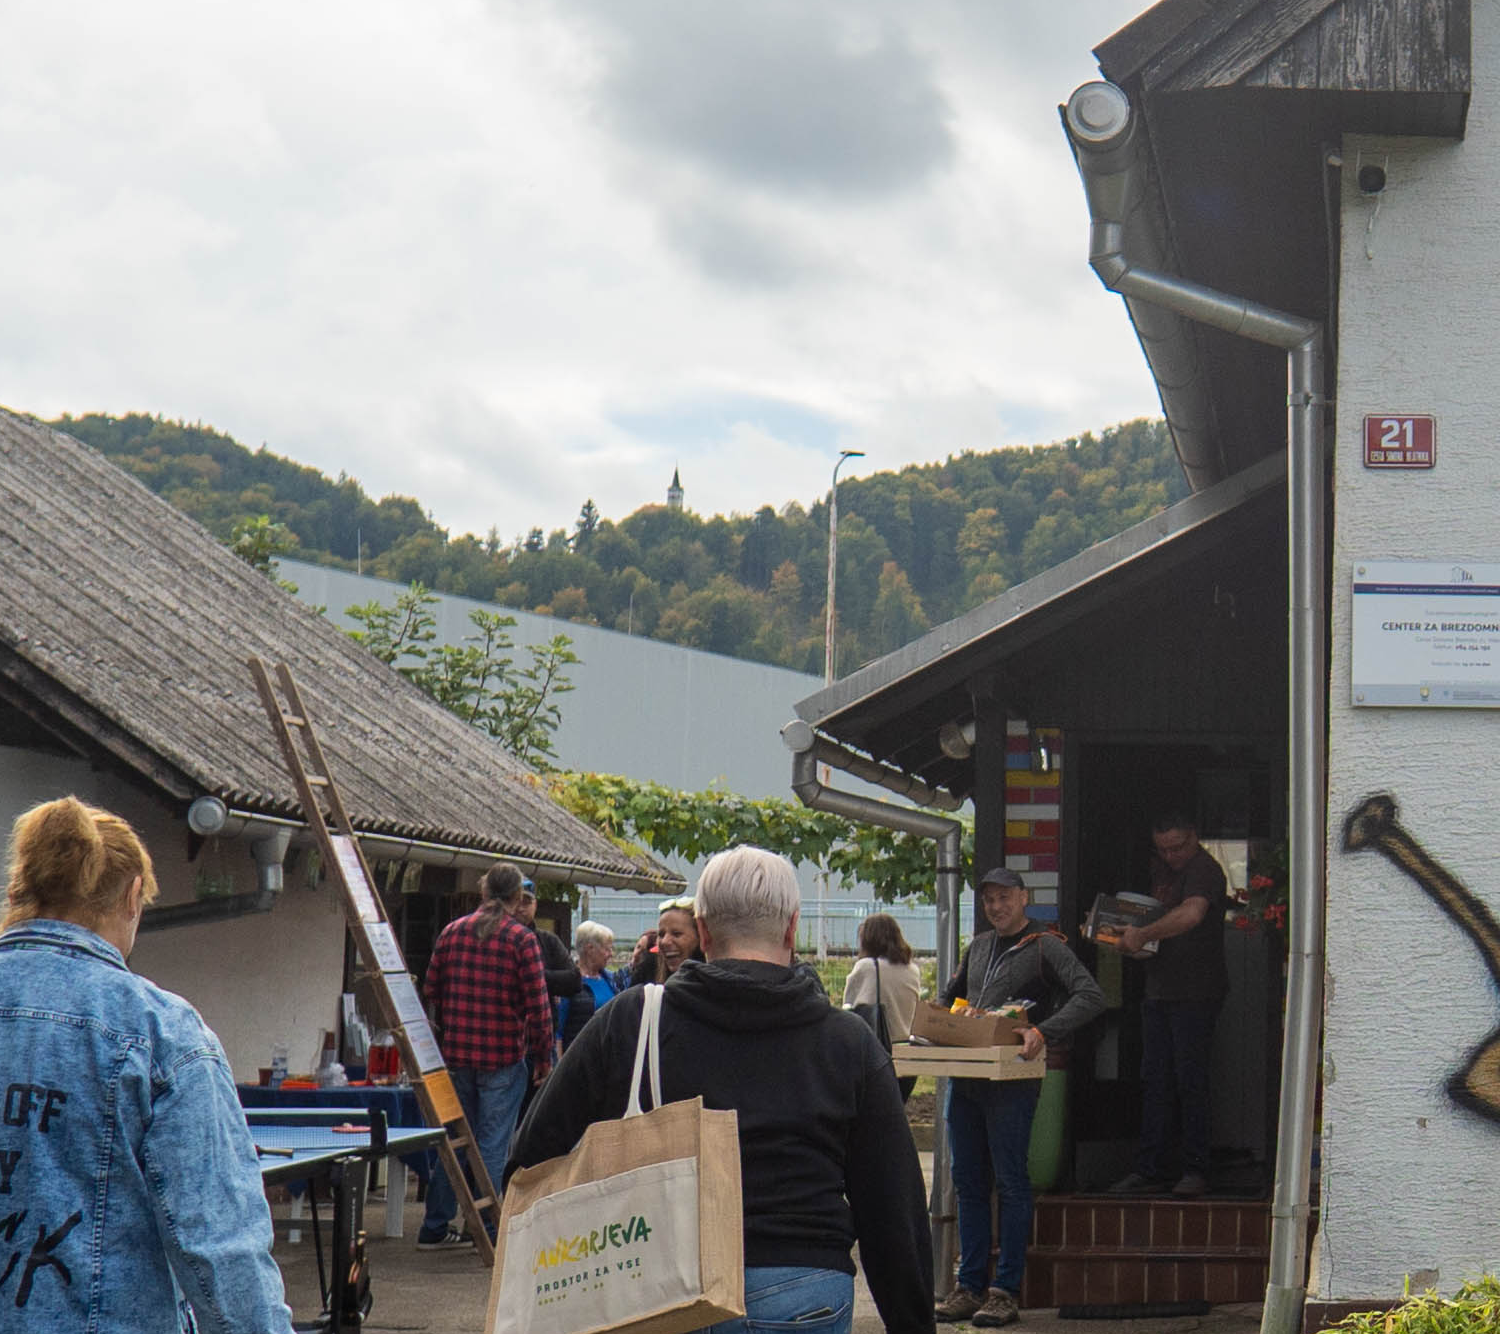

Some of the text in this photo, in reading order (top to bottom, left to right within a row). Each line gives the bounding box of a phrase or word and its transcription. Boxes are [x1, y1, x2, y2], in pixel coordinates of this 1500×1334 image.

[1381, 419, 1413, 447] 21
[1381, 622, 1421, 631] CENTER
[1424, 622, 1438, 632] ZA
[3, 1083, 69, 1134] OFF
[536, 1257, 641, 1295] PROSTOR ZA VSE
